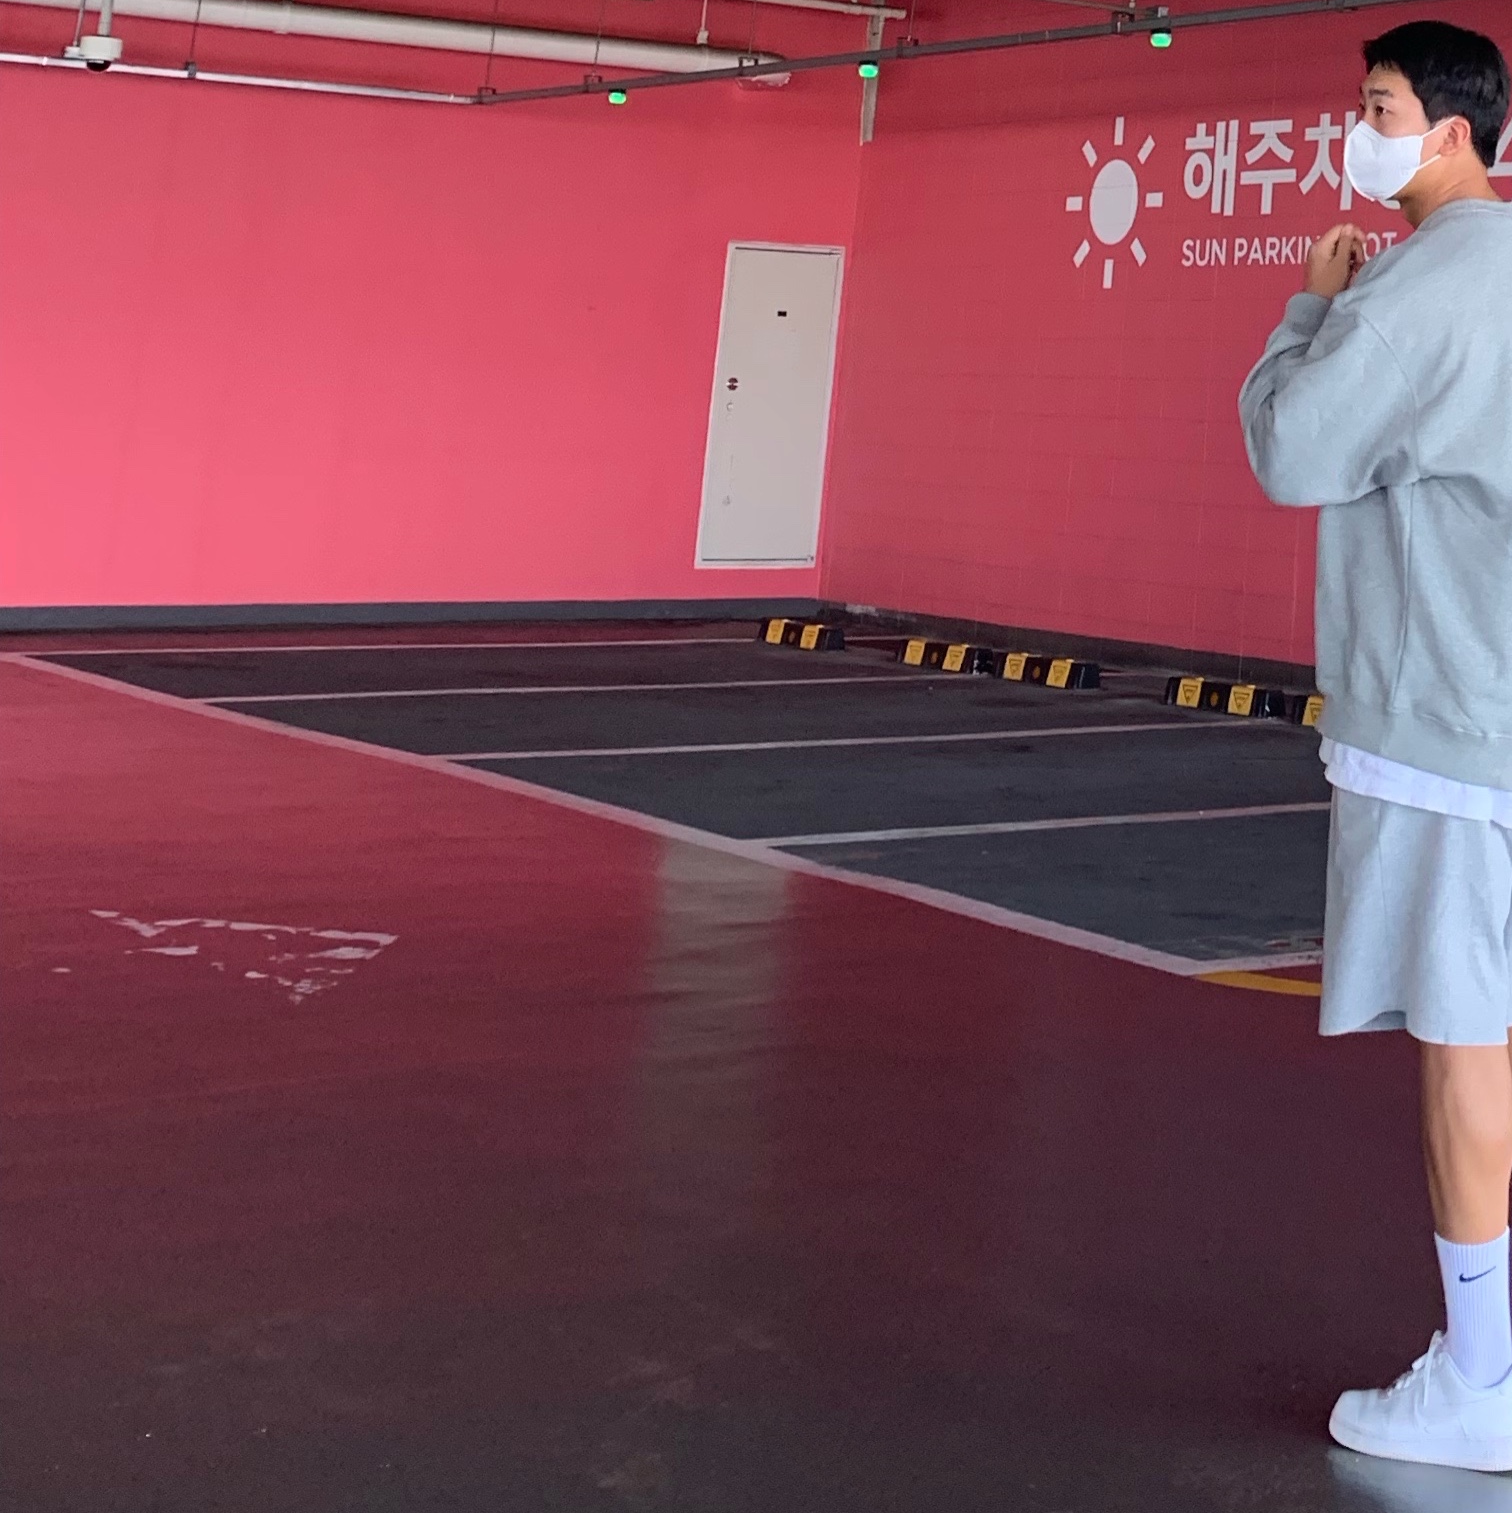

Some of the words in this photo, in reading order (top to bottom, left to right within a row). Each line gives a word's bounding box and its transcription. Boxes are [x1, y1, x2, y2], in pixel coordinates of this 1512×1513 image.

[1183, 110, 1401, 217] 해주차
[1181, 238, 1227, 268] SUN
[1233, 235, 1322, 266] PARKIN
